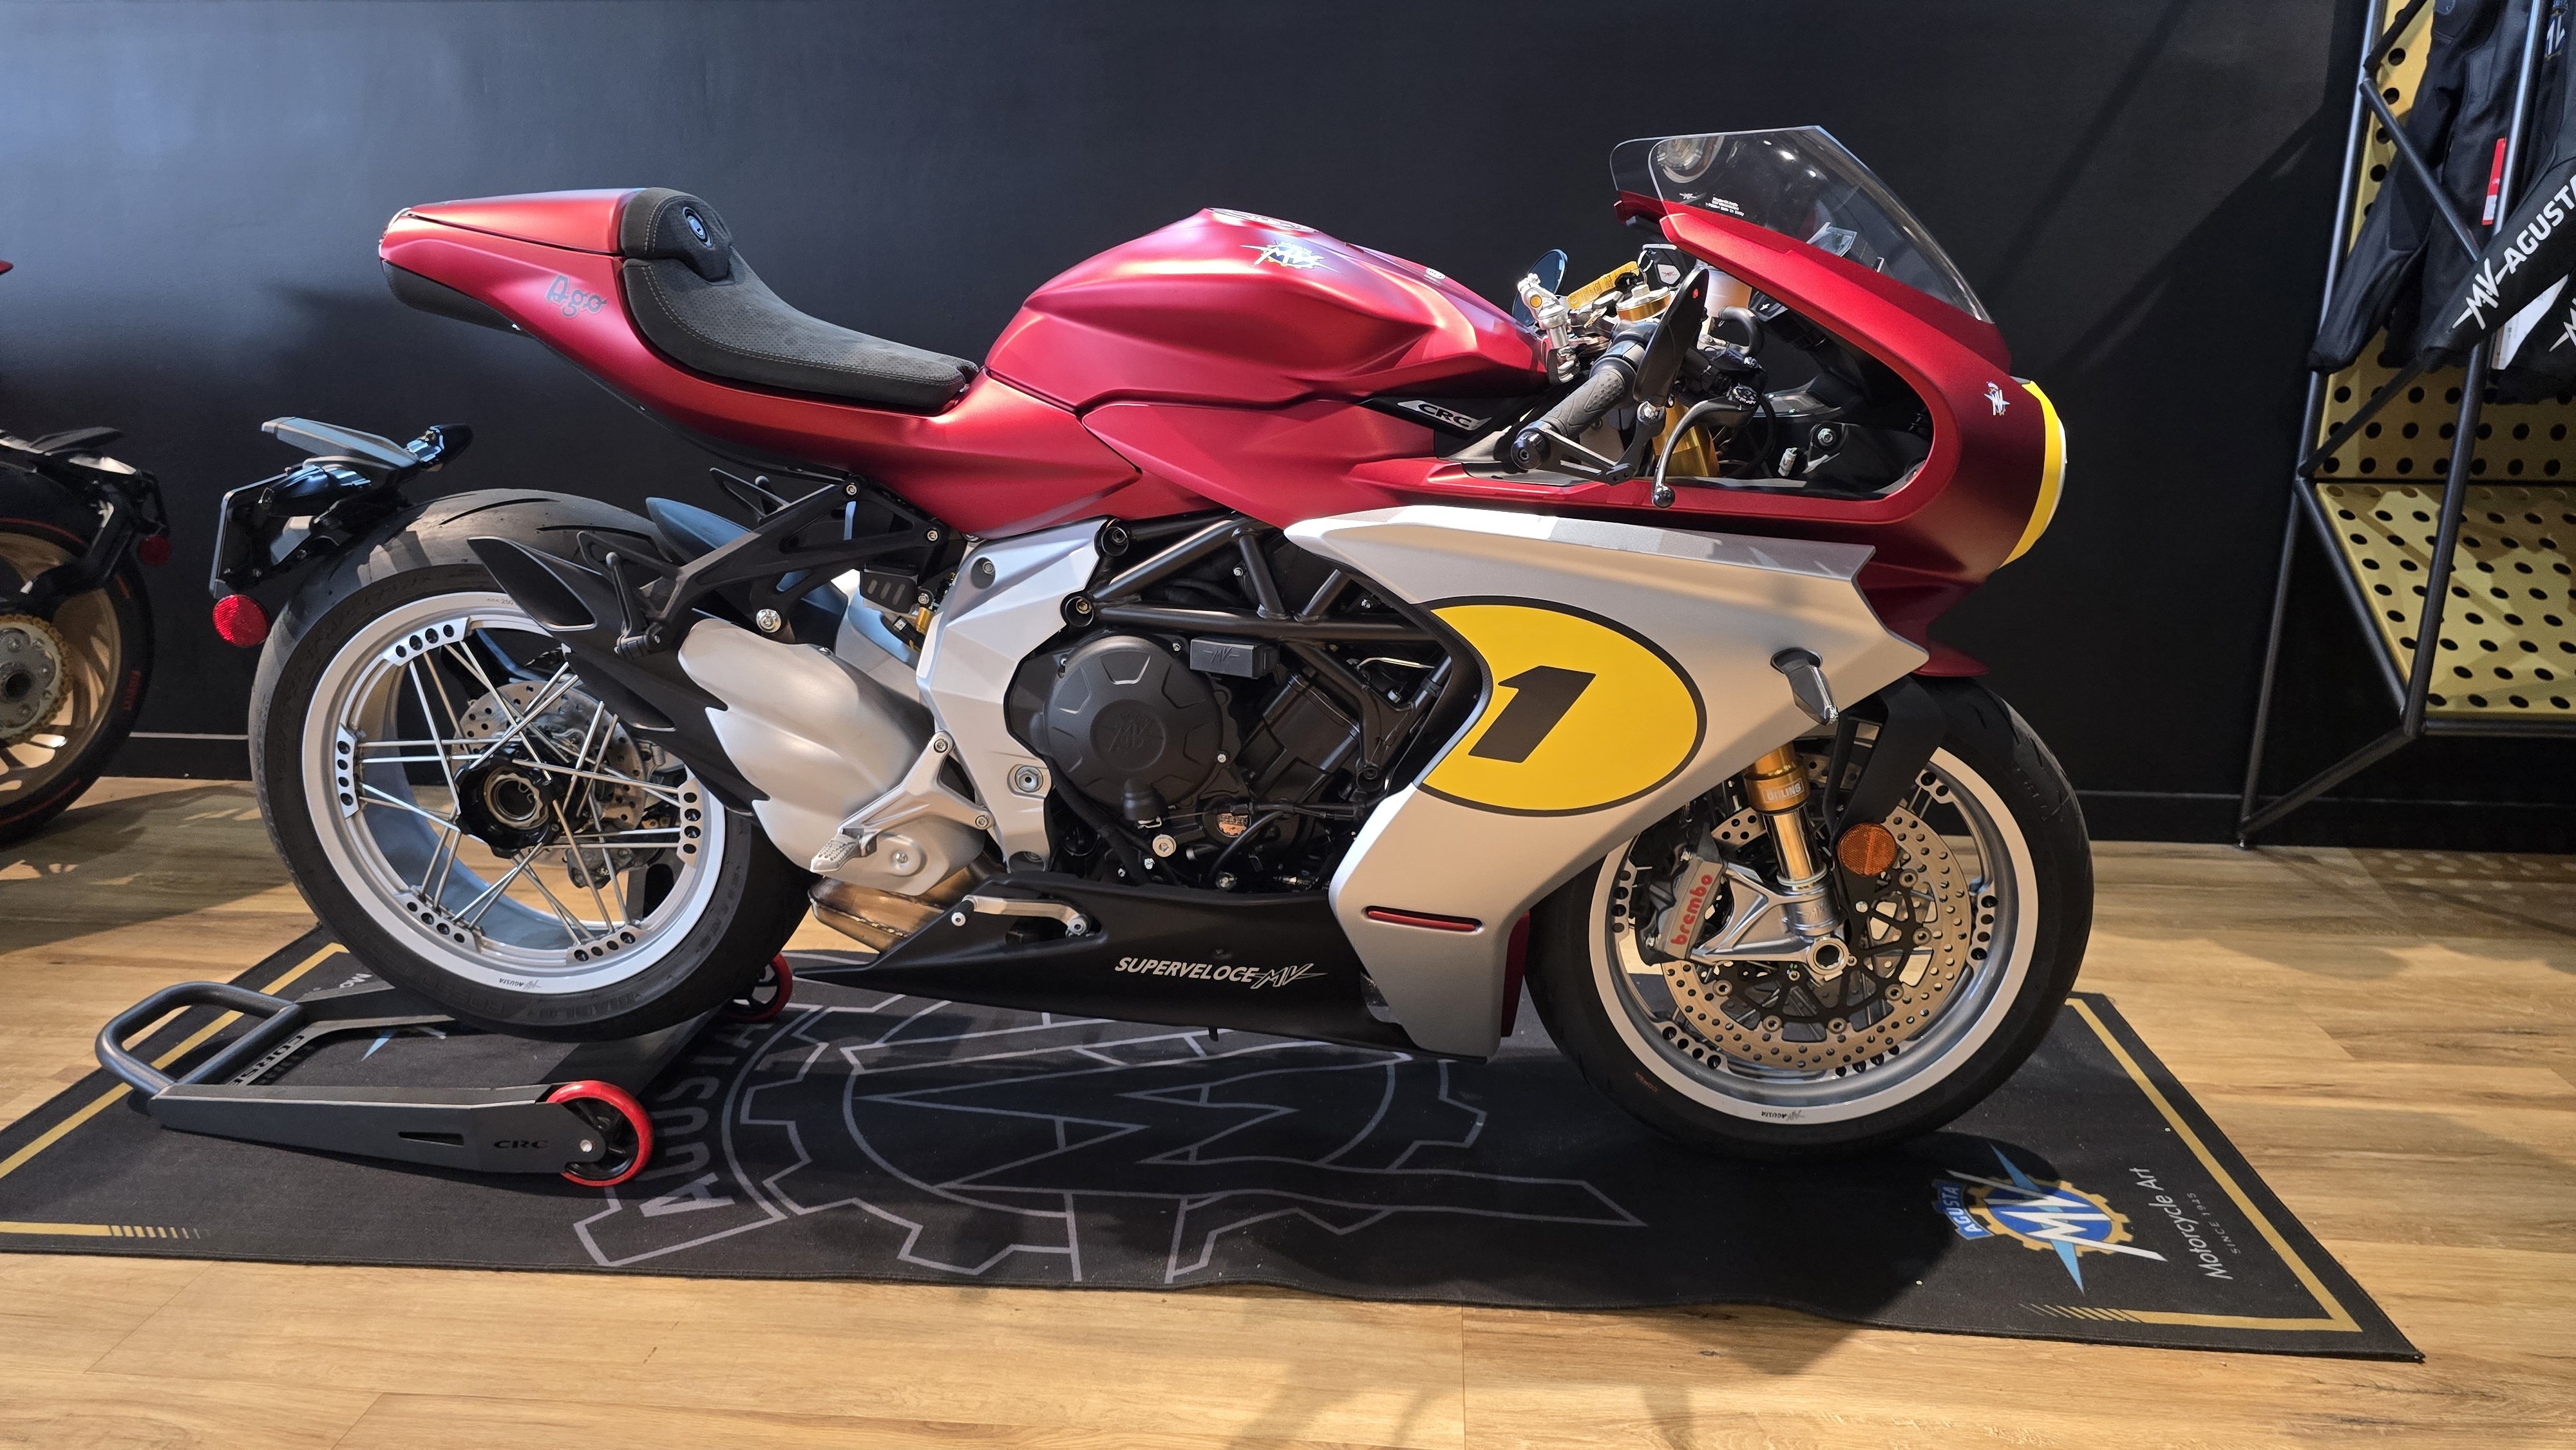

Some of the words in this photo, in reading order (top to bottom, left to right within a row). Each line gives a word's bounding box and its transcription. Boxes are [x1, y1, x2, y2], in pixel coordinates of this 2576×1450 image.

[1418, 404, 1472, 428] CRC
[1468, 665, 1596, 764] 1
[1671, 874, 1712, 945] brembo
[498, 977, 524, 987] AGUSTA
[1115, 957, 1260, 983] SUPERVELOCE
[1761, 1111, 1787, 1119] AGUSTA
[493, 1140, 548, 1149] CRC
[2128, 1167, 2164, 1191] Art
[1941, 1186, 1983, 1233] AGUSTA
[2148, 1194, 2233, 1280] Motorcycle
[2209, 1221, 2242, 1254] SINCE
